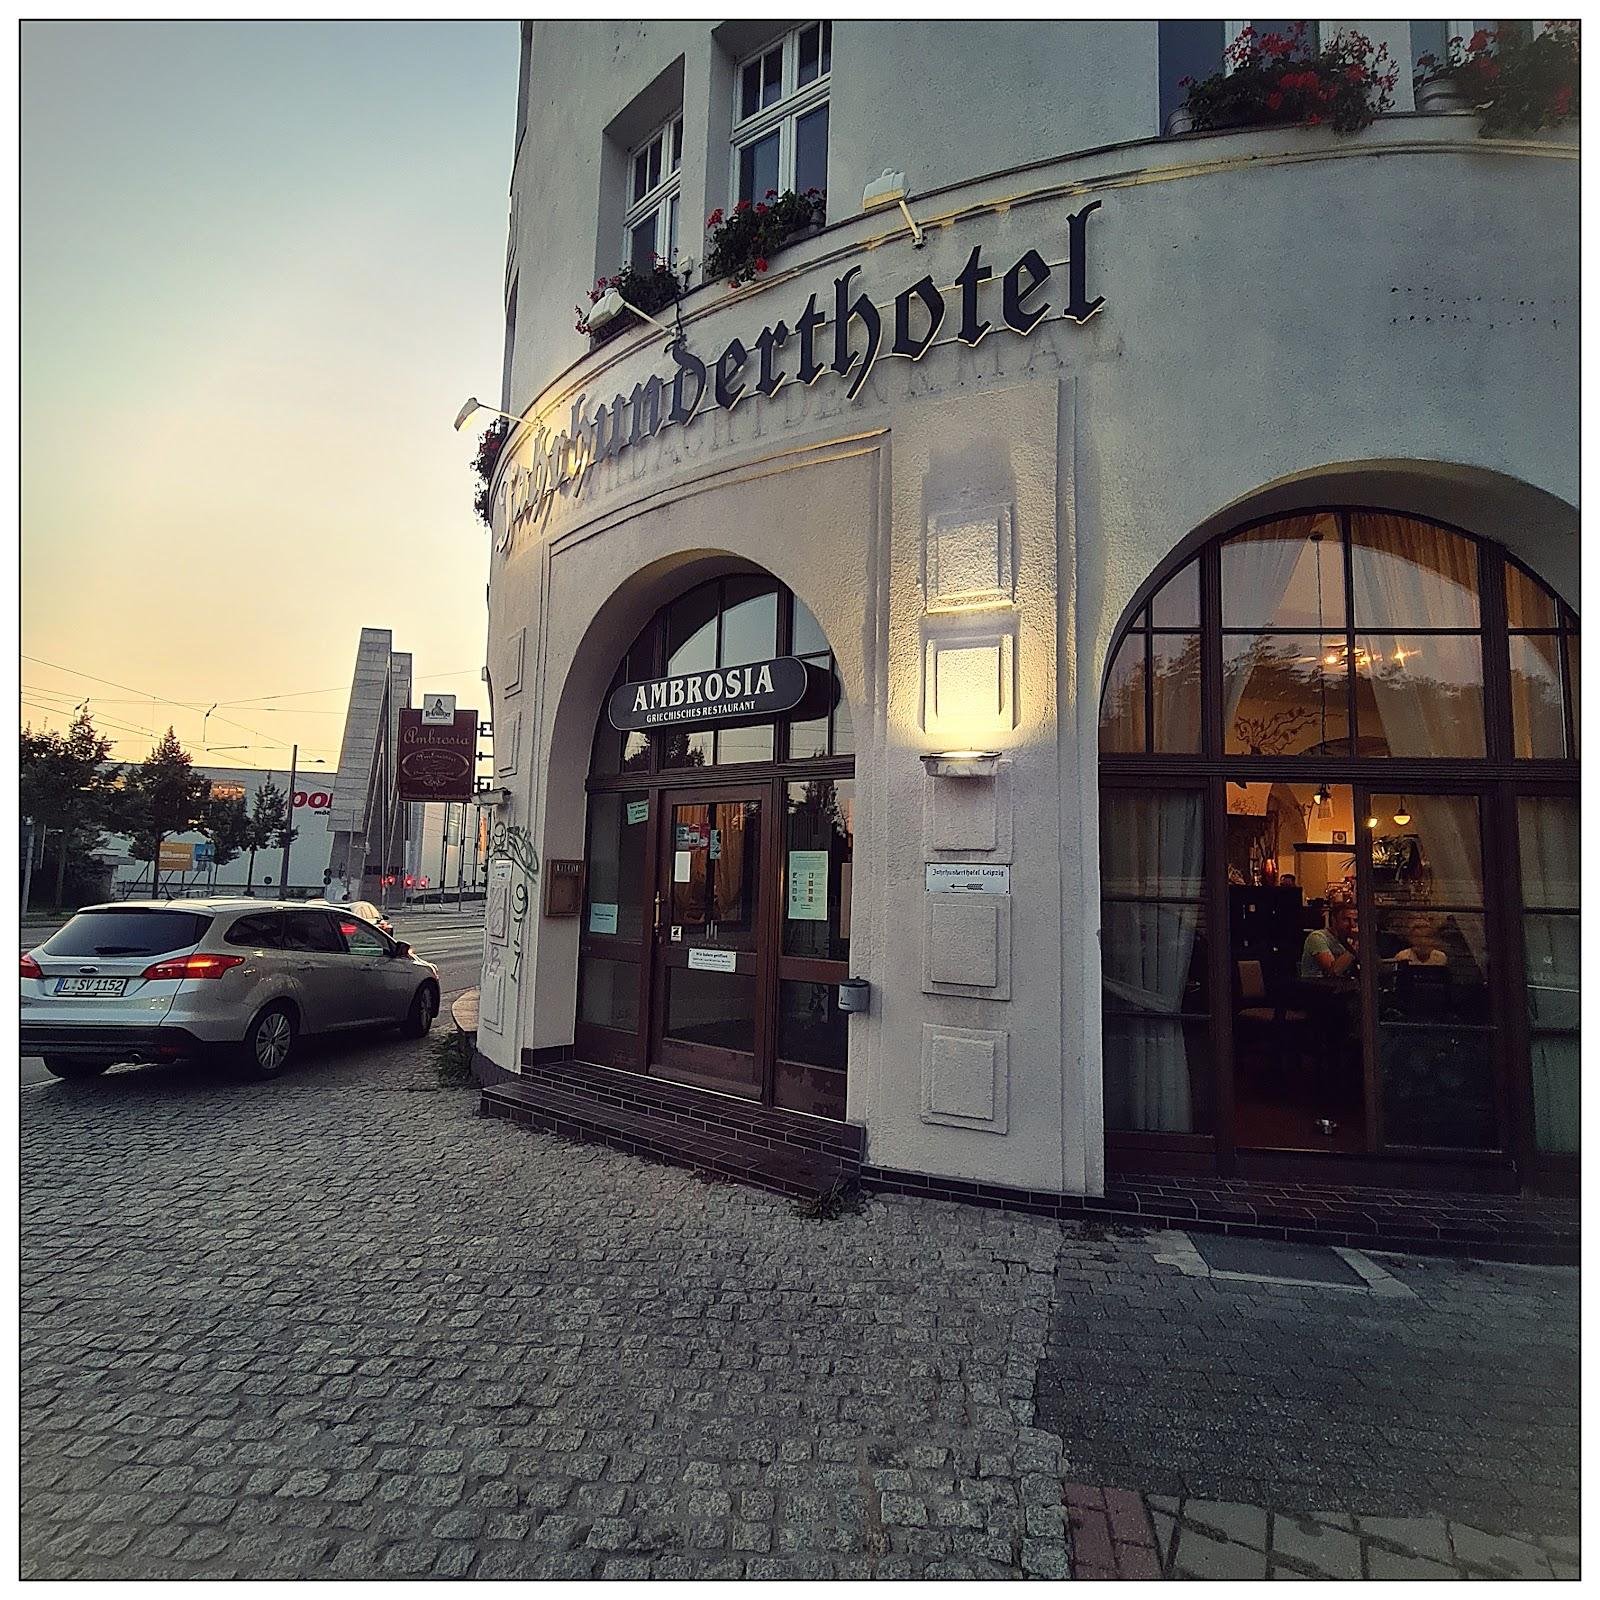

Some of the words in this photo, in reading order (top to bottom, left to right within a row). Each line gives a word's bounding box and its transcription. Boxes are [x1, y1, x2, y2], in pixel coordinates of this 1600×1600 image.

[495, 199, 1106, 552] Jahrhunderthotel
[632, 664, 775, 712] AMBROSIA
[646, 707, 701, 723] GRIECHISCHES
[703, 700, 756, 717] RESTAURANT
[404, 726, 470, 745] Ambrosia
[982, 869, 1004, 877] Leipzig
[63, 979, 70, 990] L
[77, 979, 94, 990] SV
[94, 979, 123, 991] 1152
